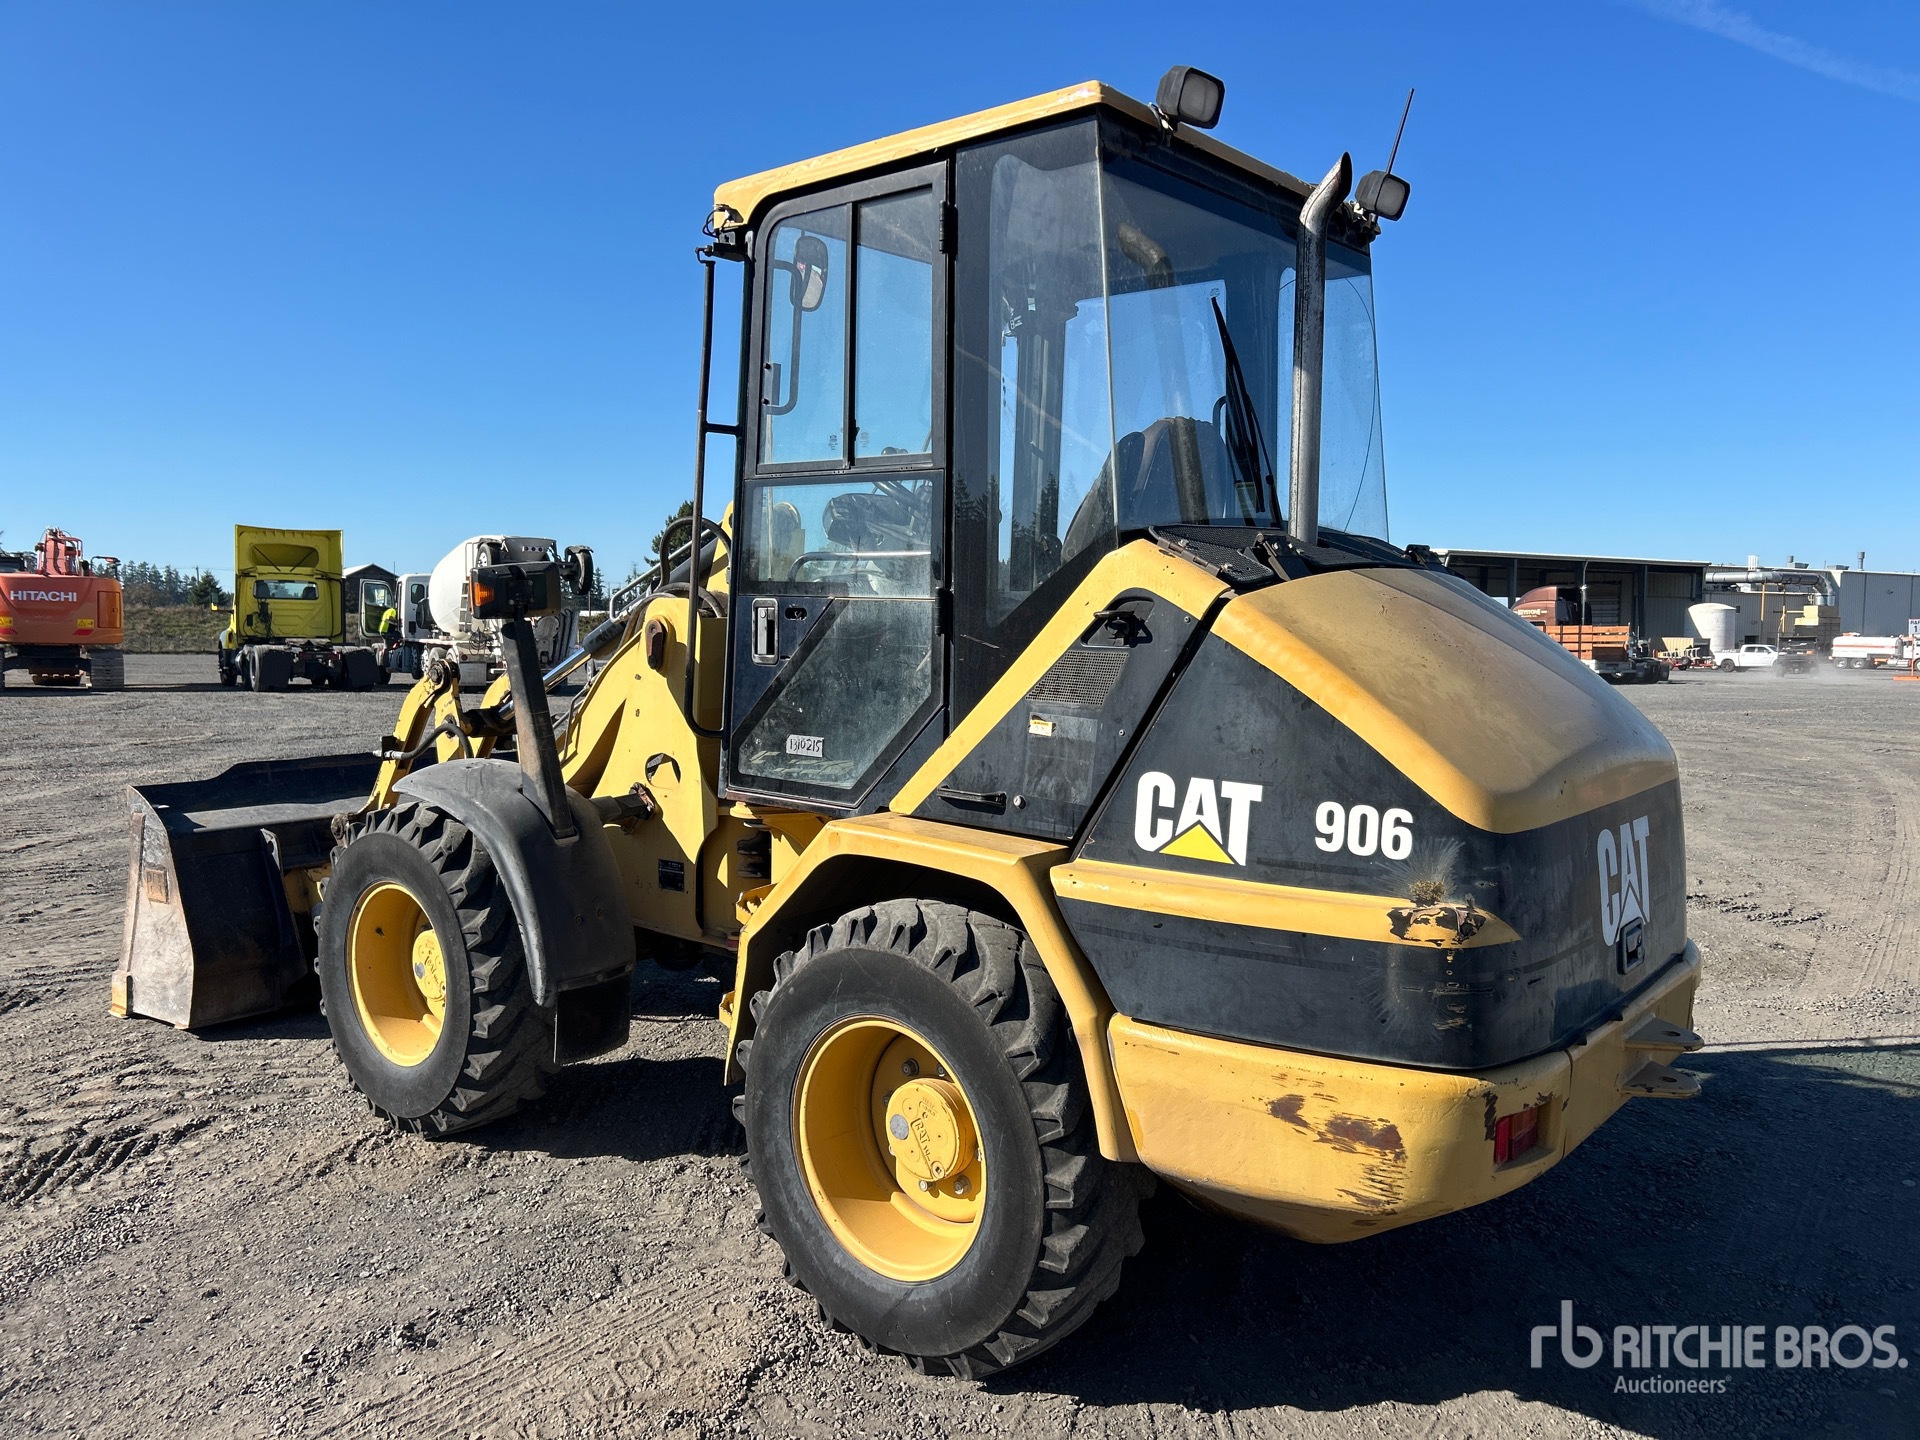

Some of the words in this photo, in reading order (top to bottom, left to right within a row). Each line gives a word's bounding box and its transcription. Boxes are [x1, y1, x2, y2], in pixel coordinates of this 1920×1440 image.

[10, 590, 77, 602] HITACHI
[1134, 771, 1263, 866] CAT
[1315, 801, 1413, 860] 906
[1597, 815, 1650, 946] CAT
